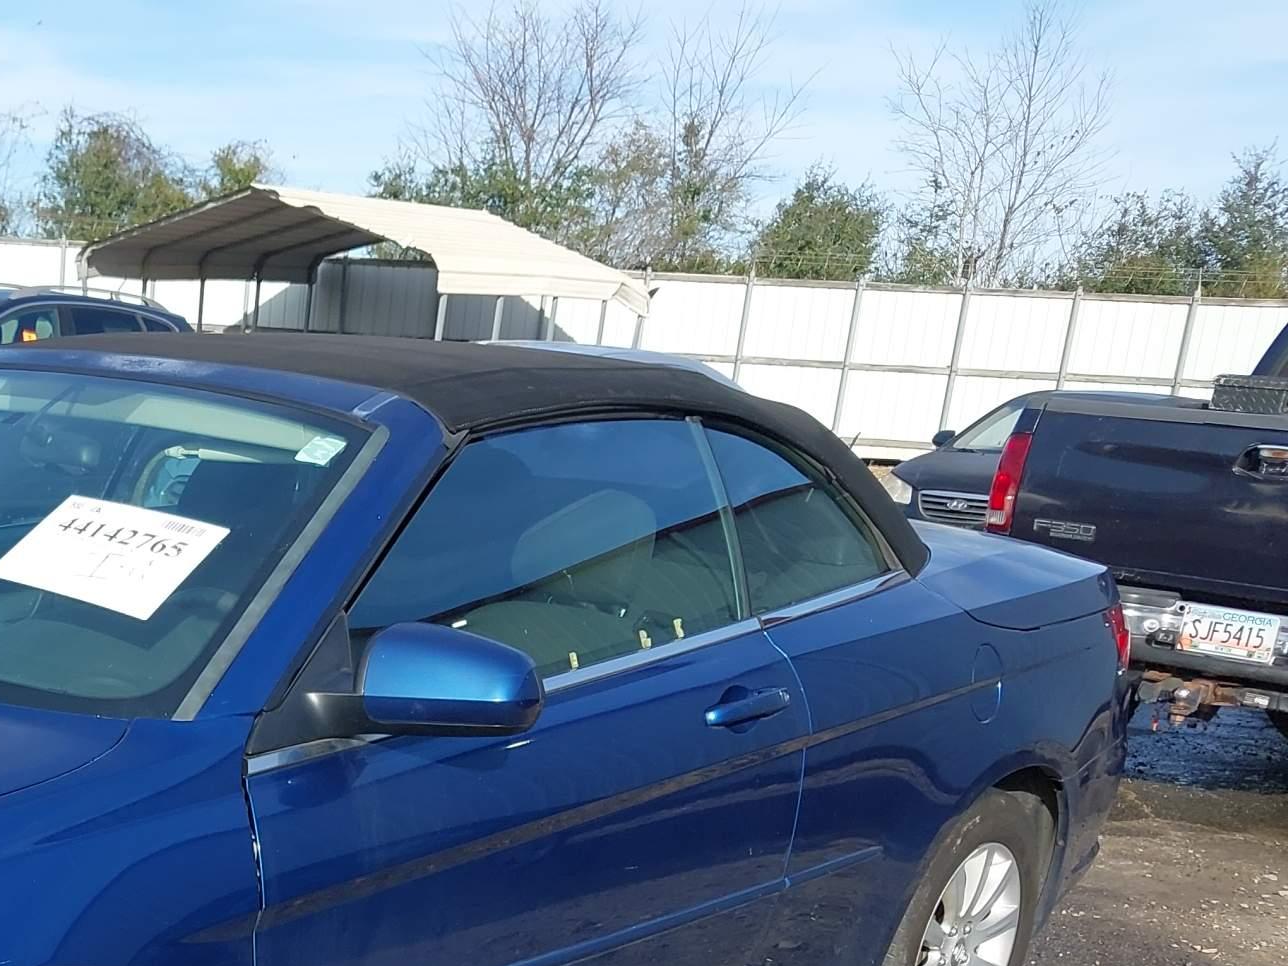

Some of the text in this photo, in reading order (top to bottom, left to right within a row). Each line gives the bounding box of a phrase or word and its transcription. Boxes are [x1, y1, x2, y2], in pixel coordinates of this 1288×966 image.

[58, 517, 190, 558] 44142765
[1033, 518, 1097, 536] F350
[1222, 612, 1273, 628] GEORGIA
[1189, 618, 1266, 649] SJF5415
